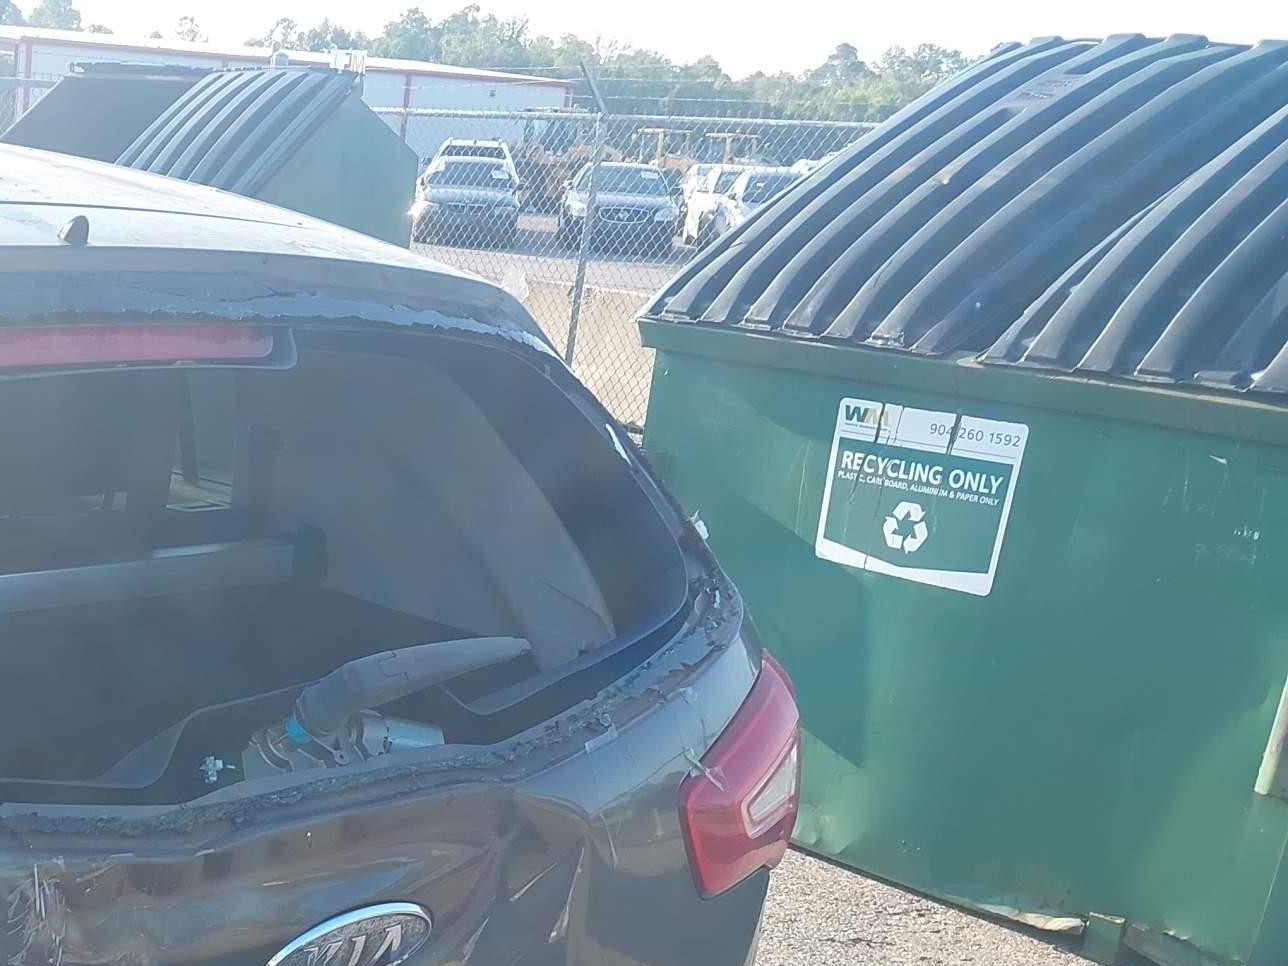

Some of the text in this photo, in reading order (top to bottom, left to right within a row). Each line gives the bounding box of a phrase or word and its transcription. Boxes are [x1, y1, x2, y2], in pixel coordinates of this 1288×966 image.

[845, 405, 889, 427] WM
[959, 427, 984, 442] 260
[989, 432, 1021, 447] 1592
[841, 450, 1004, 494] RECYCLING ONLY
[838, 470, 866, 484] PLASTC,
[948, 489, 956, 499] &
[956, 491, 979, 503] PAPER
[979, 496, 1000, 507] ONLY
